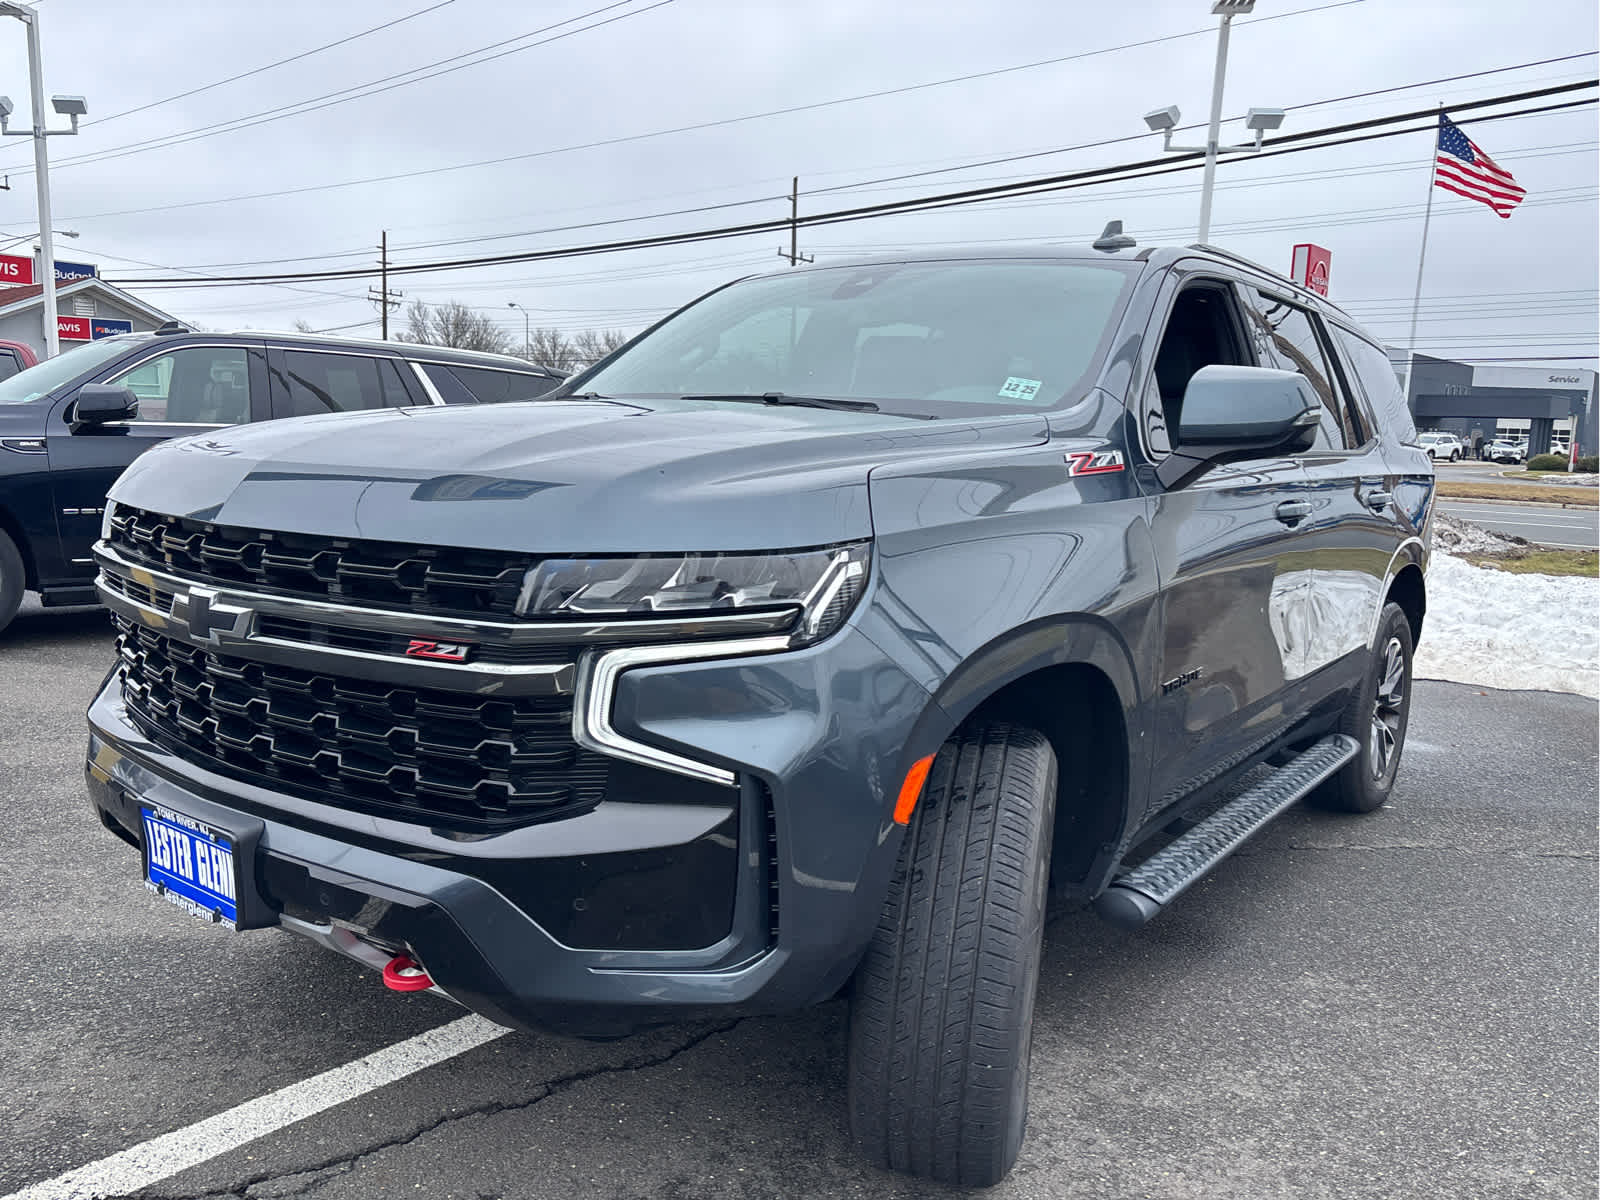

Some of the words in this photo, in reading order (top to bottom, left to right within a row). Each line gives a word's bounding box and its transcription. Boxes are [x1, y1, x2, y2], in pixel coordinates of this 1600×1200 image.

[58, 323, 81, 332] AVIS
[1548, 375, 1580, 384] Service
[1005, 383, 1020, 392] 12
[1064, 450, 1125, 477] Z71
[406, 639, 469, 661] Z71
[146, 819, 194, 881] LESTER
[195, 839, 237, 901] GLENN
